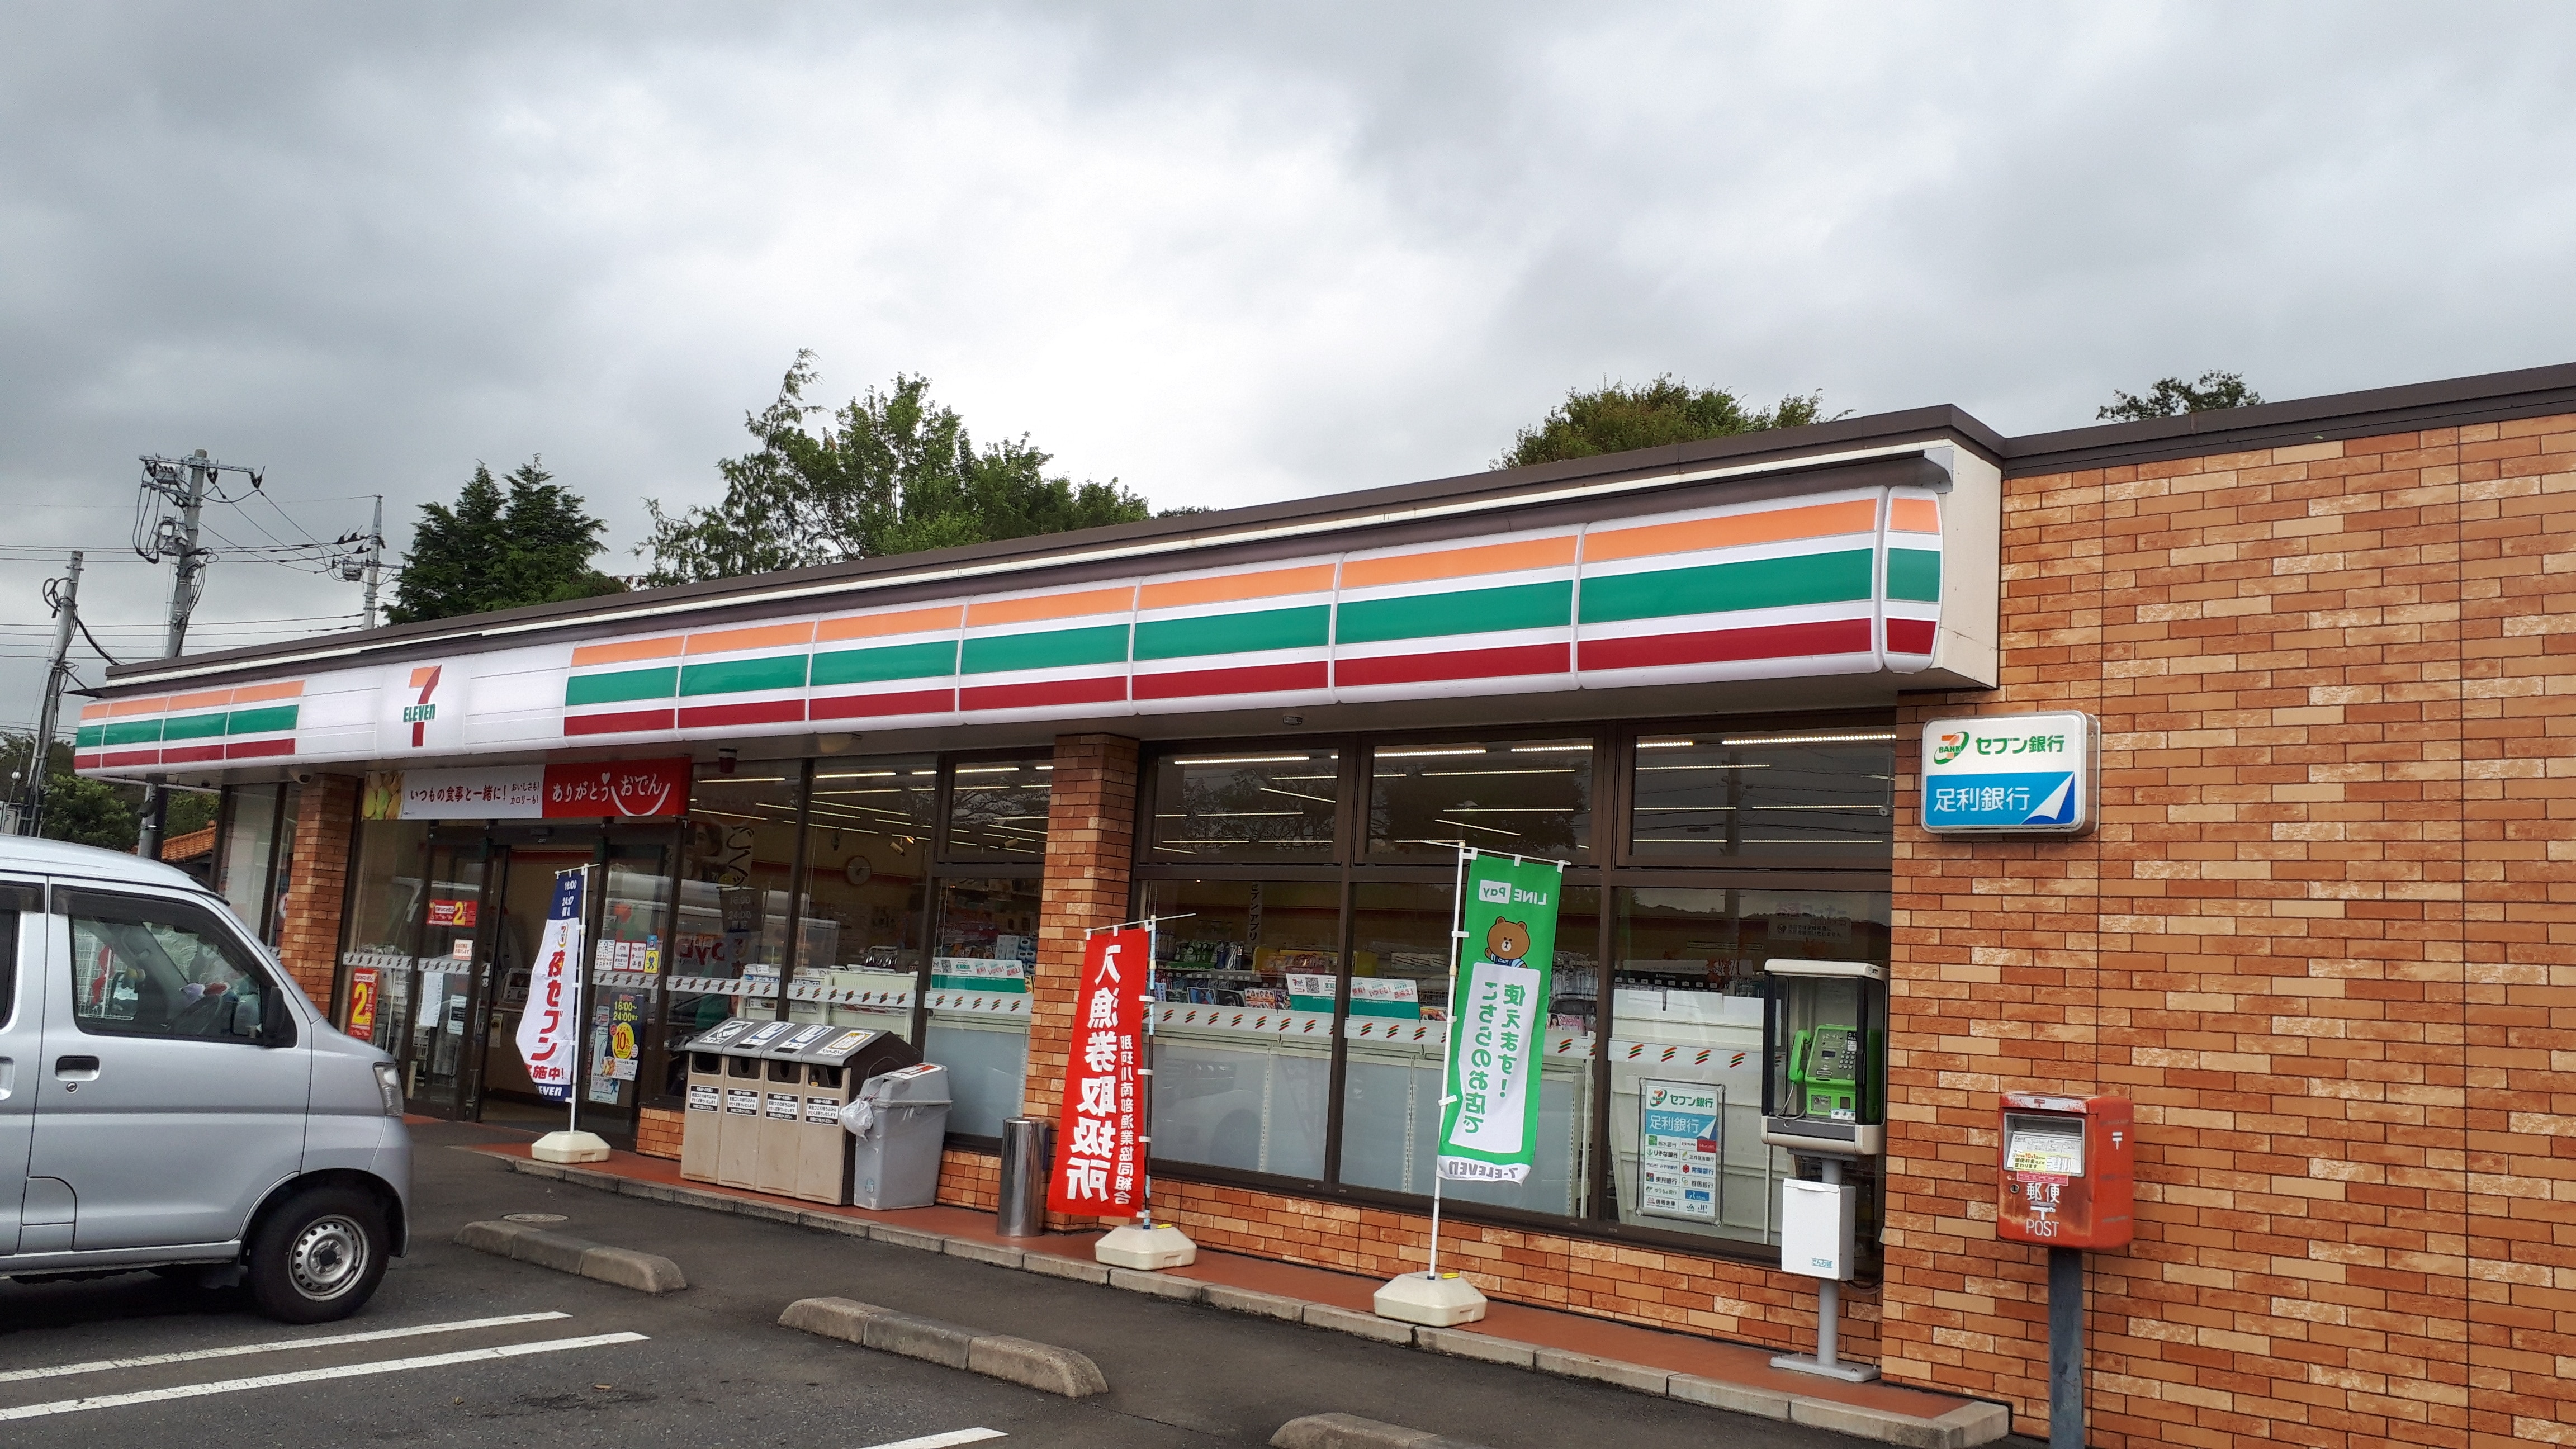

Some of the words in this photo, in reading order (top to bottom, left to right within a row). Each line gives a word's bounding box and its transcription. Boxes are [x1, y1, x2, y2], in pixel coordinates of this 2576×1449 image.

[409, 664, 442, 747] 7
[1976, 735, 2064, 755] セブン銀行
[410, 784, 506, 802] いつもの食事と一緒に!
[552, 776, 609, 803] ありがとう
[620, 773, 663, 797] おでん
[1934, 787, 2030, 812] 足利銀行
[531, 950, 566, 1061] 夜セブン
[1670, 1094, 1713, 1108] セブン銀行
[1650, 1115, 1699, 1133] 足利銀行
[2026, 1183, 2060, 1204] 郵便
[2026, 1219, 2060, 1238] POST
